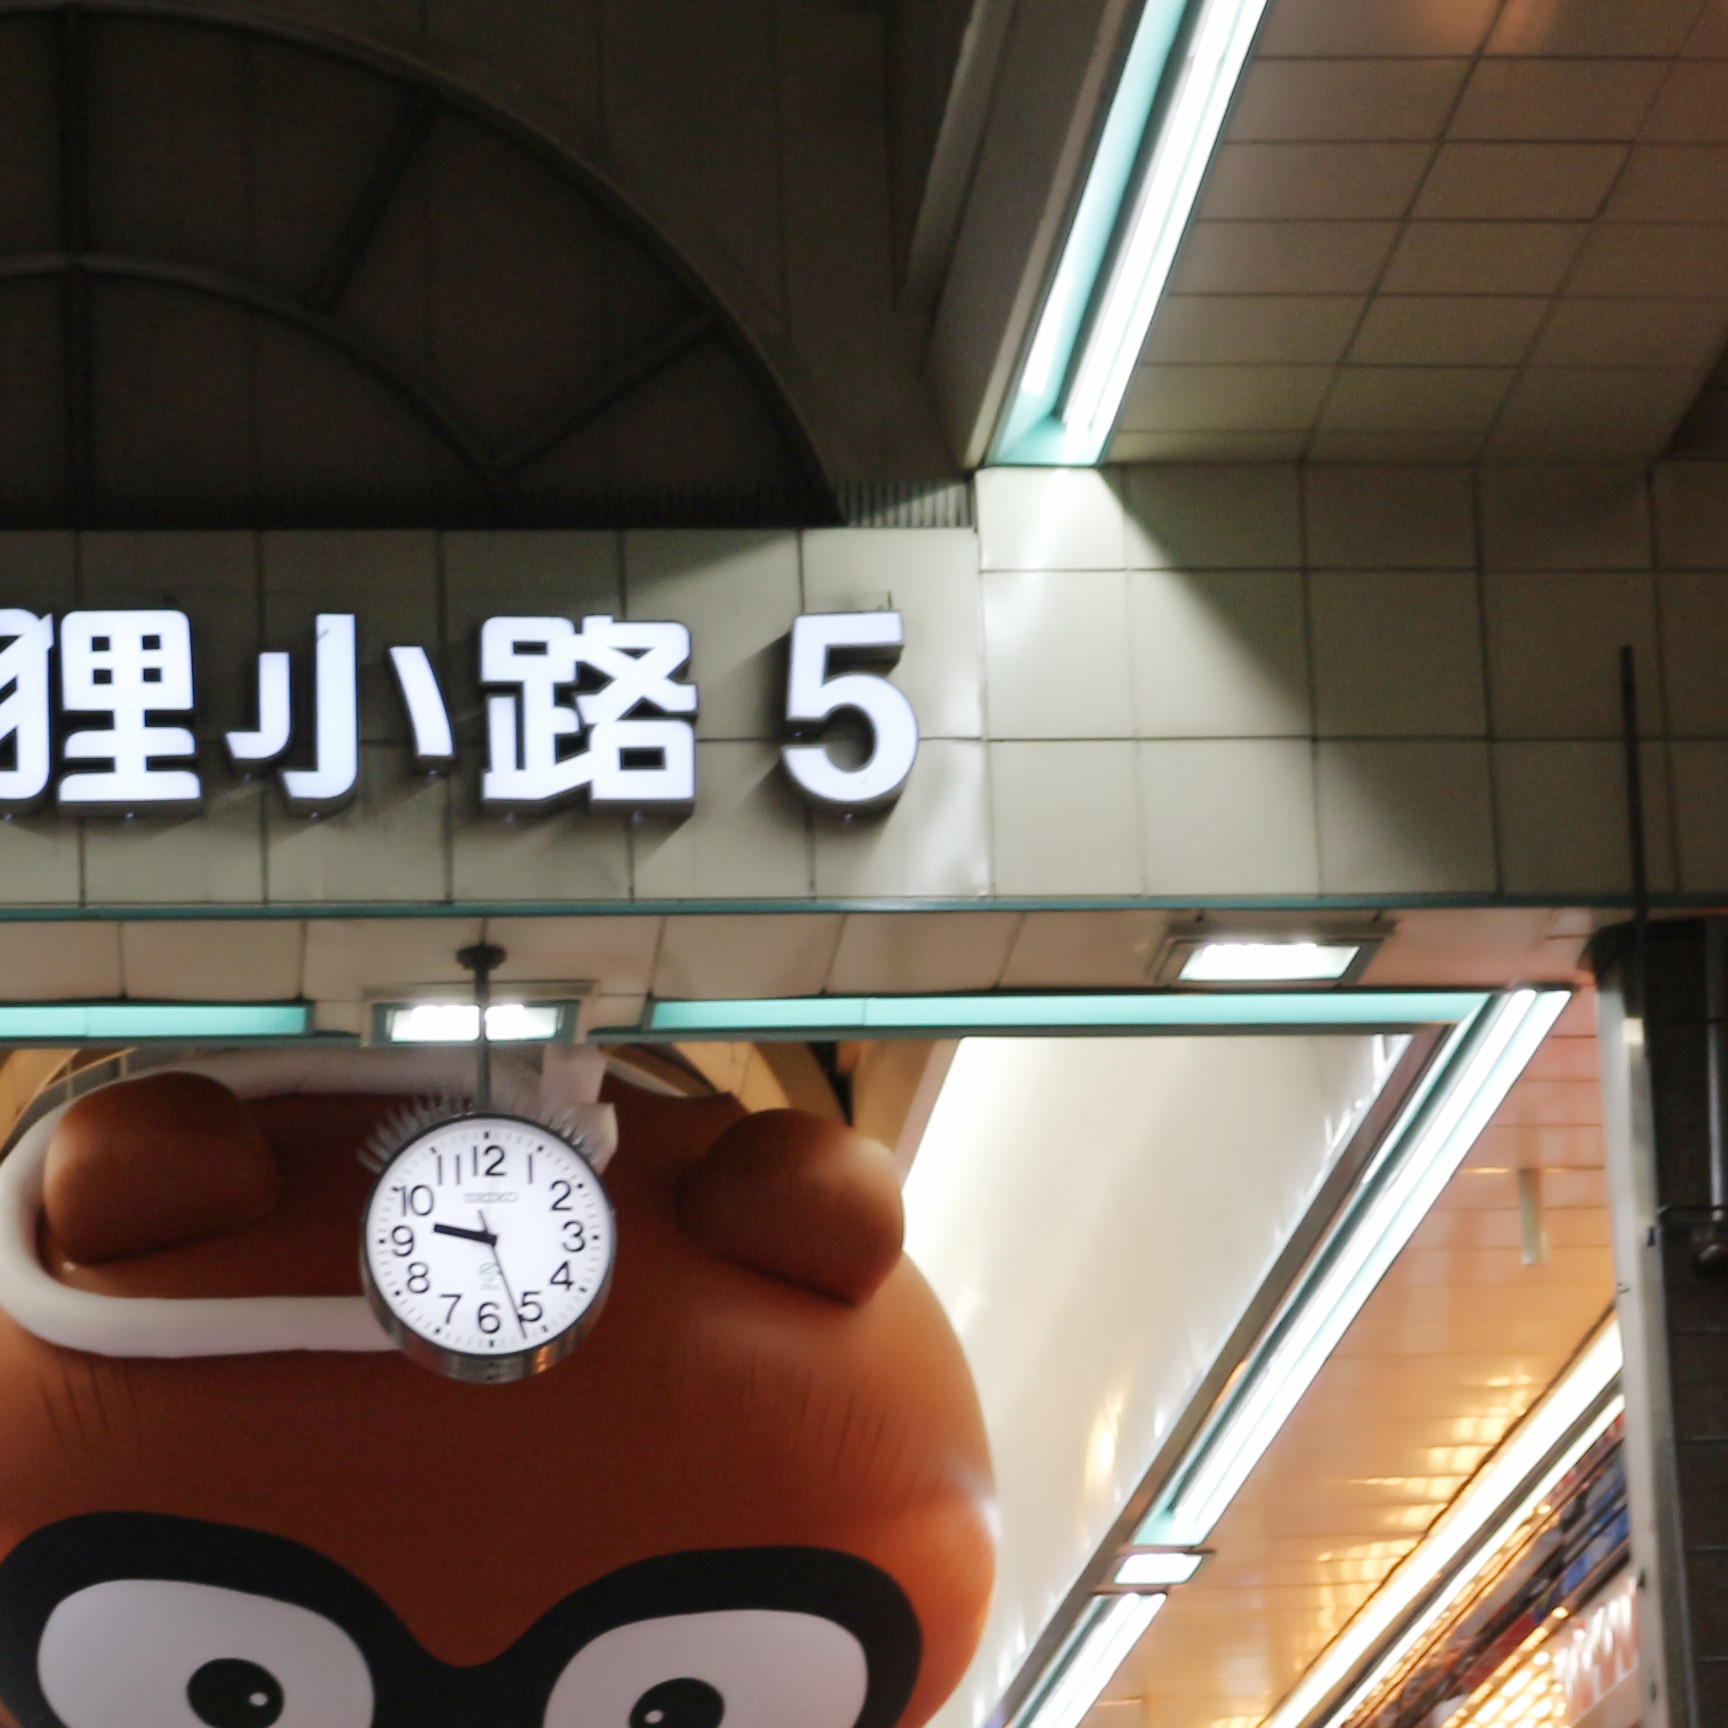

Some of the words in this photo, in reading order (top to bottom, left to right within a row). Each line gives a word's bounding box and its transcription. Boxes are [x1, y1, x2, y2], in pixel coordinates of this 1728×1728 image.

[782, 610, 919, 800] 5
[473, 1145, 507, 1177] 12
[396, 1185, 434, 1216] 10
[550, 1180, 572, 1211] 2
[391, 1225, 414, 1257] 9
[561, 1221, 585, 1252] 3
[406, 1262, 430, 1294] 8
[550, 1261, 573, 1290] 4
[440, 1294, 462, 1325] 7
[478, 1302, 501, 1334] 6
[517, 1291, 543, 1323] 5
